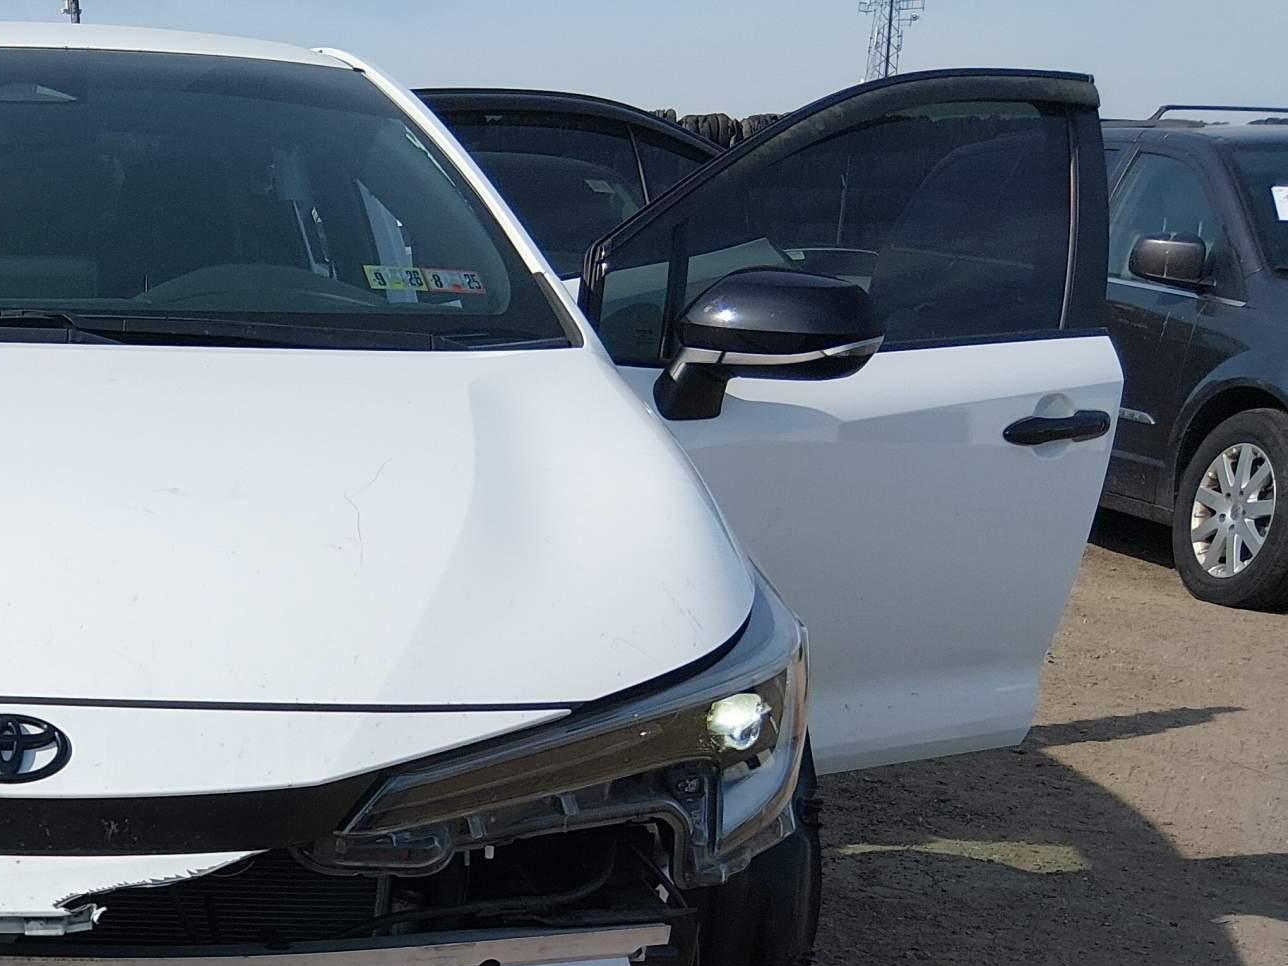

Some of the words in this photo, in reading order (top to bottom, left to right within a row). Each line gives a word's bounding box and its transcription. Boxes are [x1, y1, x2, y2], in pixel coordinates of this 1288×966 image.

[374, 271, 387, 287] 9
[405, 270, 424, 287] 26
[432, 273, 444, 289] 8
[463, 273, 482, 289] 25
